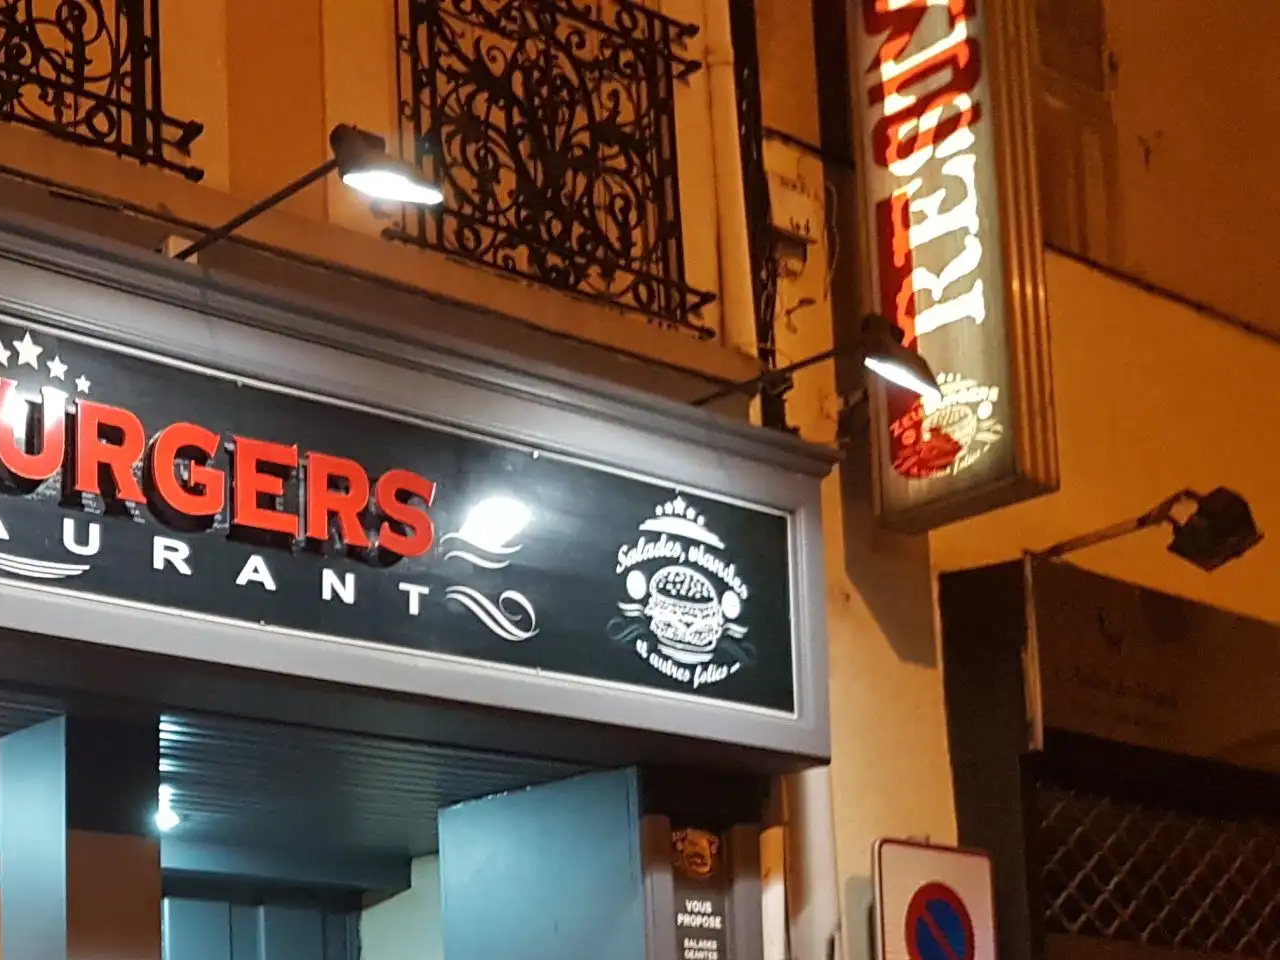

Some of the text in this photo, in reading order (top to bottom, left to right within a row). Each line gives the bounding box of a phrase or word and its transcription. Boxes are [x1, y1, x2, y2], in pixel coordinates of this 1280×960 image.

[688, 544, 749, 600] viandes
[649, 653, 691, 683] autres
[693, 664, 728, 689] folies
[685, 899, 712, 914] VOUS
[677, 912, 722, 929] PROPOSE
[684, 937, 718, 950] SALADES
